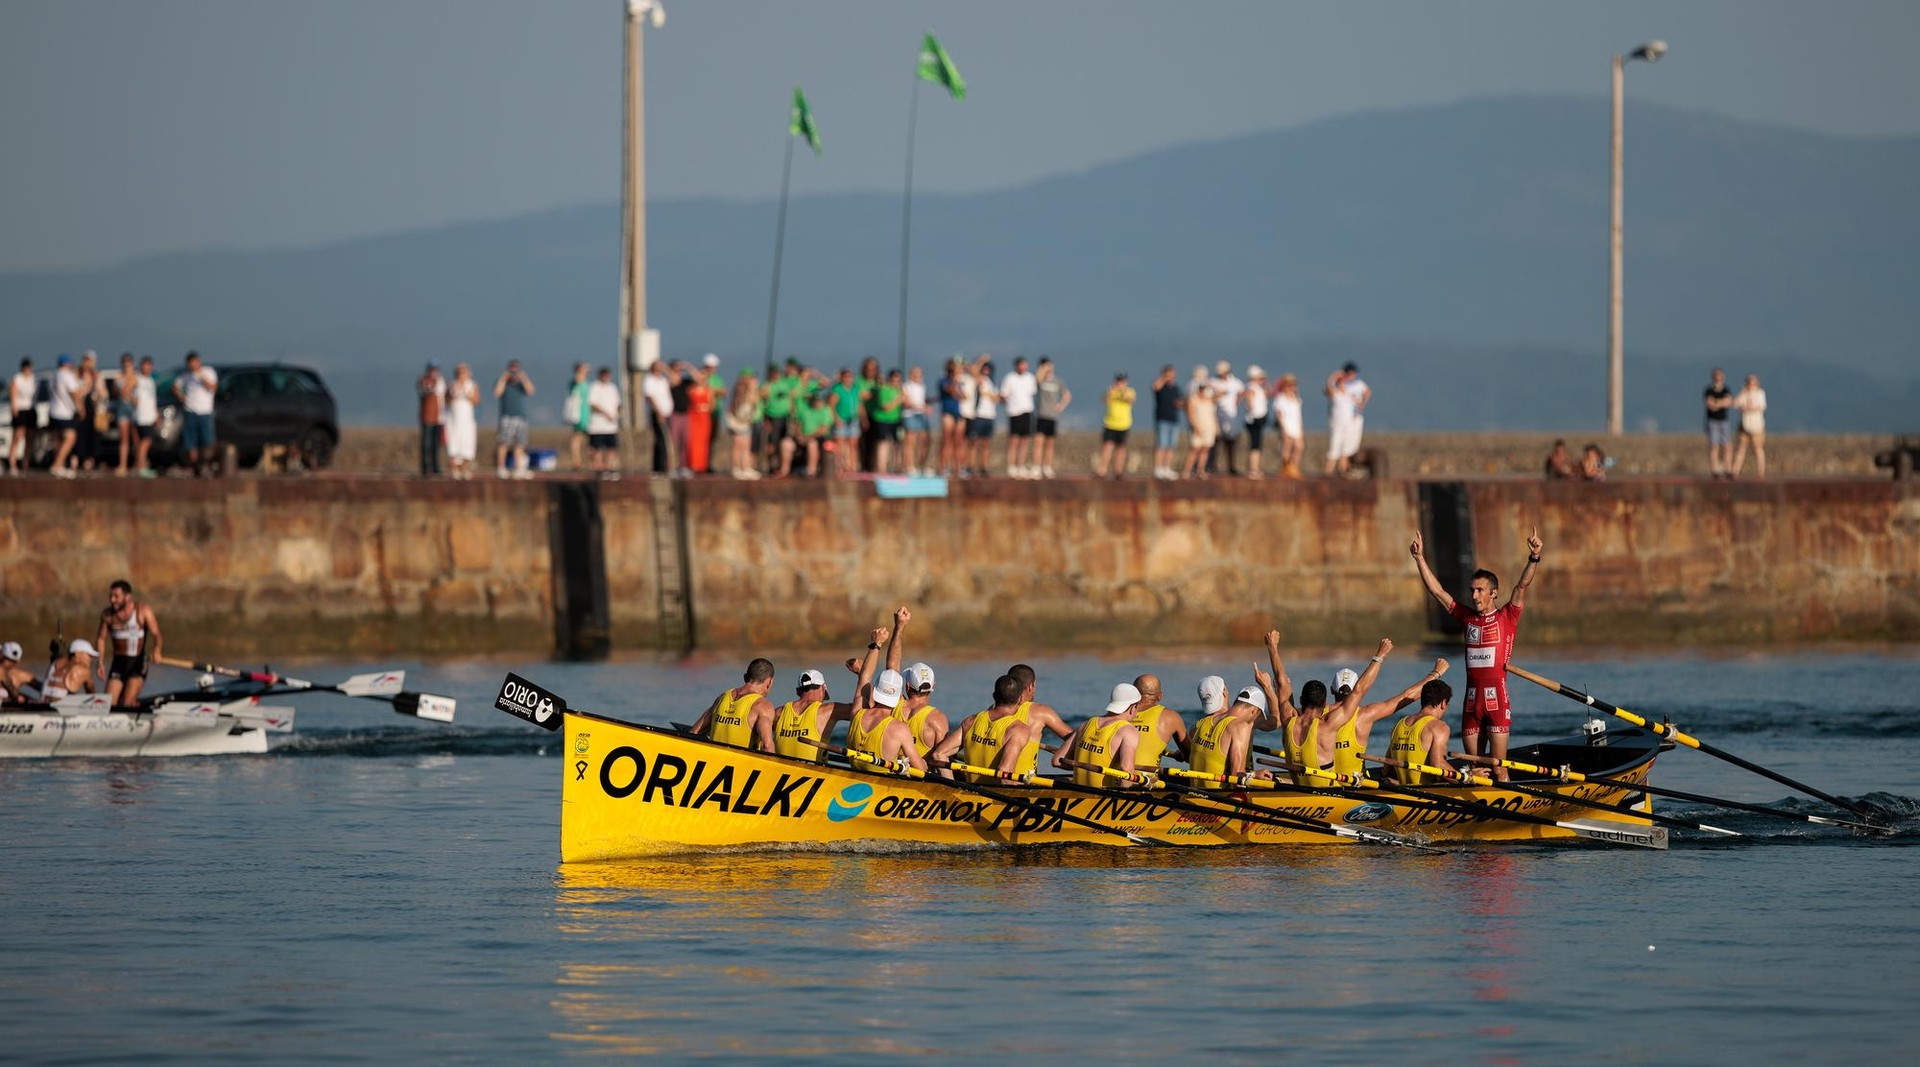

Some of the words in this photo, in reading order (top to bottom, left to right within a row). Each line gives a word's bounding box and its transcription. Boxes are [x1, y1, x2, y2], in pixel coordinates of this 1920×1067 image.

[504, 681, 539, 708] ORIO
[715, 713, 741, 726] auma
[780, 728, 809, 738] auma
[971, 732, 997, 747] auma
[1079, 740, 1105, 755] auma
[599, 745, 826, 818] ORIALKI
[874, 795, 992, 823] ORBINOX
